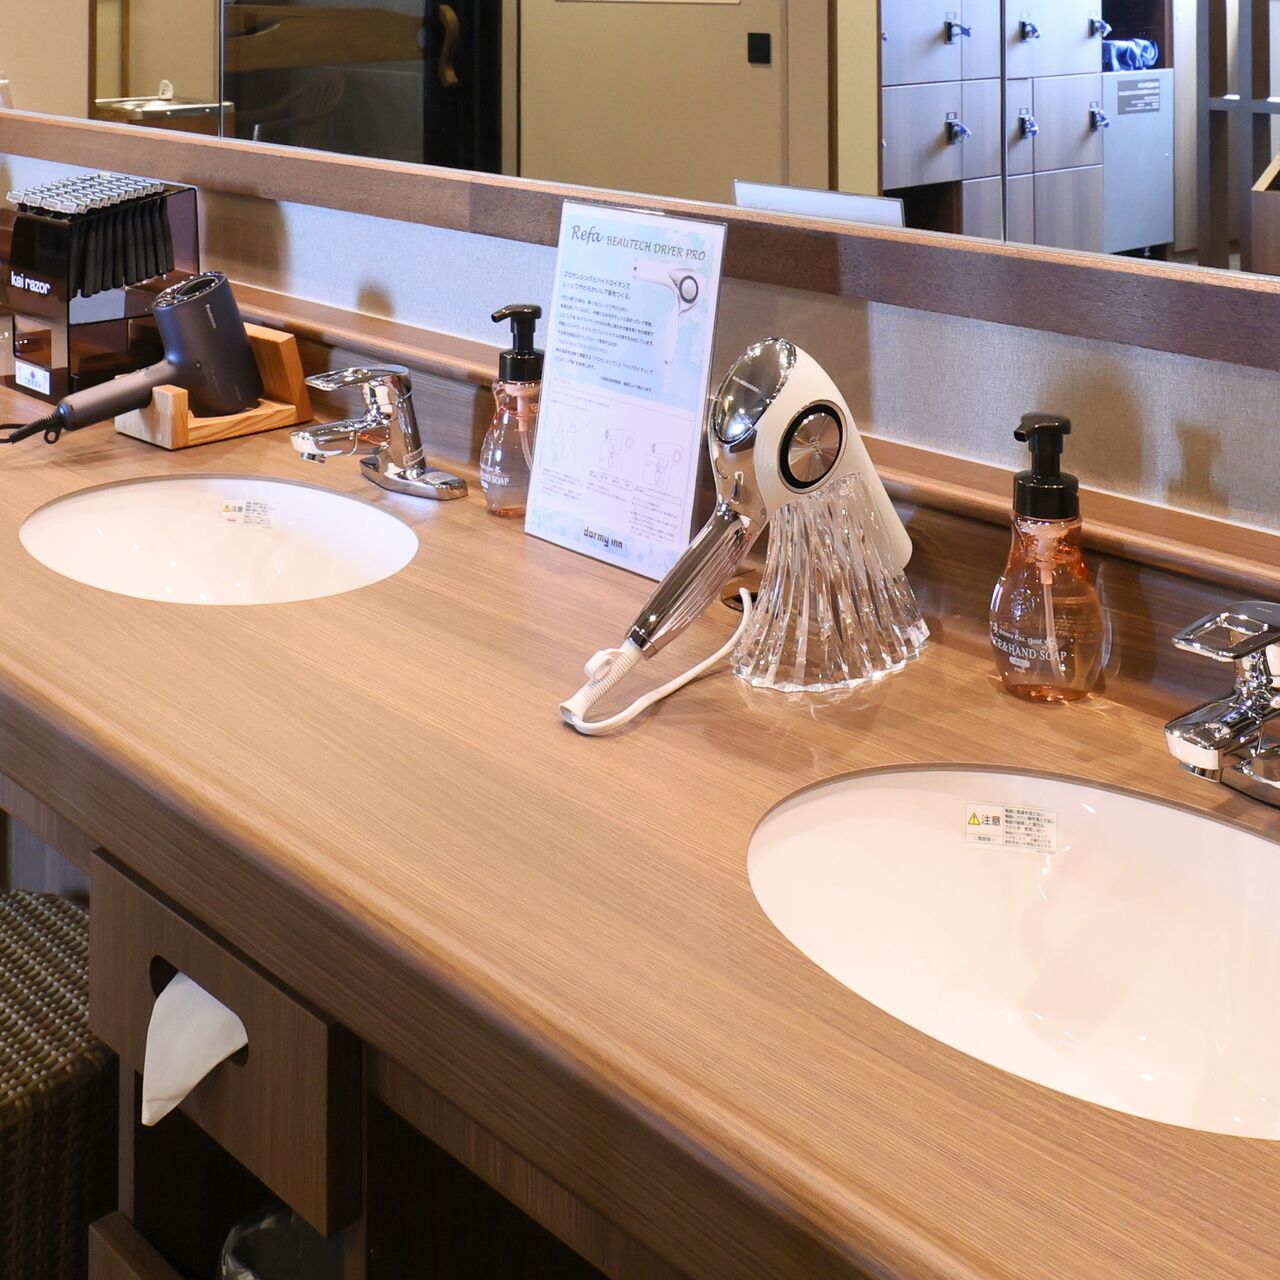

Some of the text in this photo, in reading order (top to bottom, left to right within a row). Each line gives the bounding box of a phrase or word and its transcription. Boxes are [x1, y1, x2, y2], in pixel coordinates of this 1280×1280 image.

[606, 235, 652, 253] BEAUTECH
[653, 242, 683, 257] DRYER
[685, 248, 706, 262] PRO
[11, 271, 51, 295] kai razor
[583, 527, 623, 550] dormy inn
[1039, 650, 1067, 662] SOAP
[981, 814, 1000, 826] 注意
